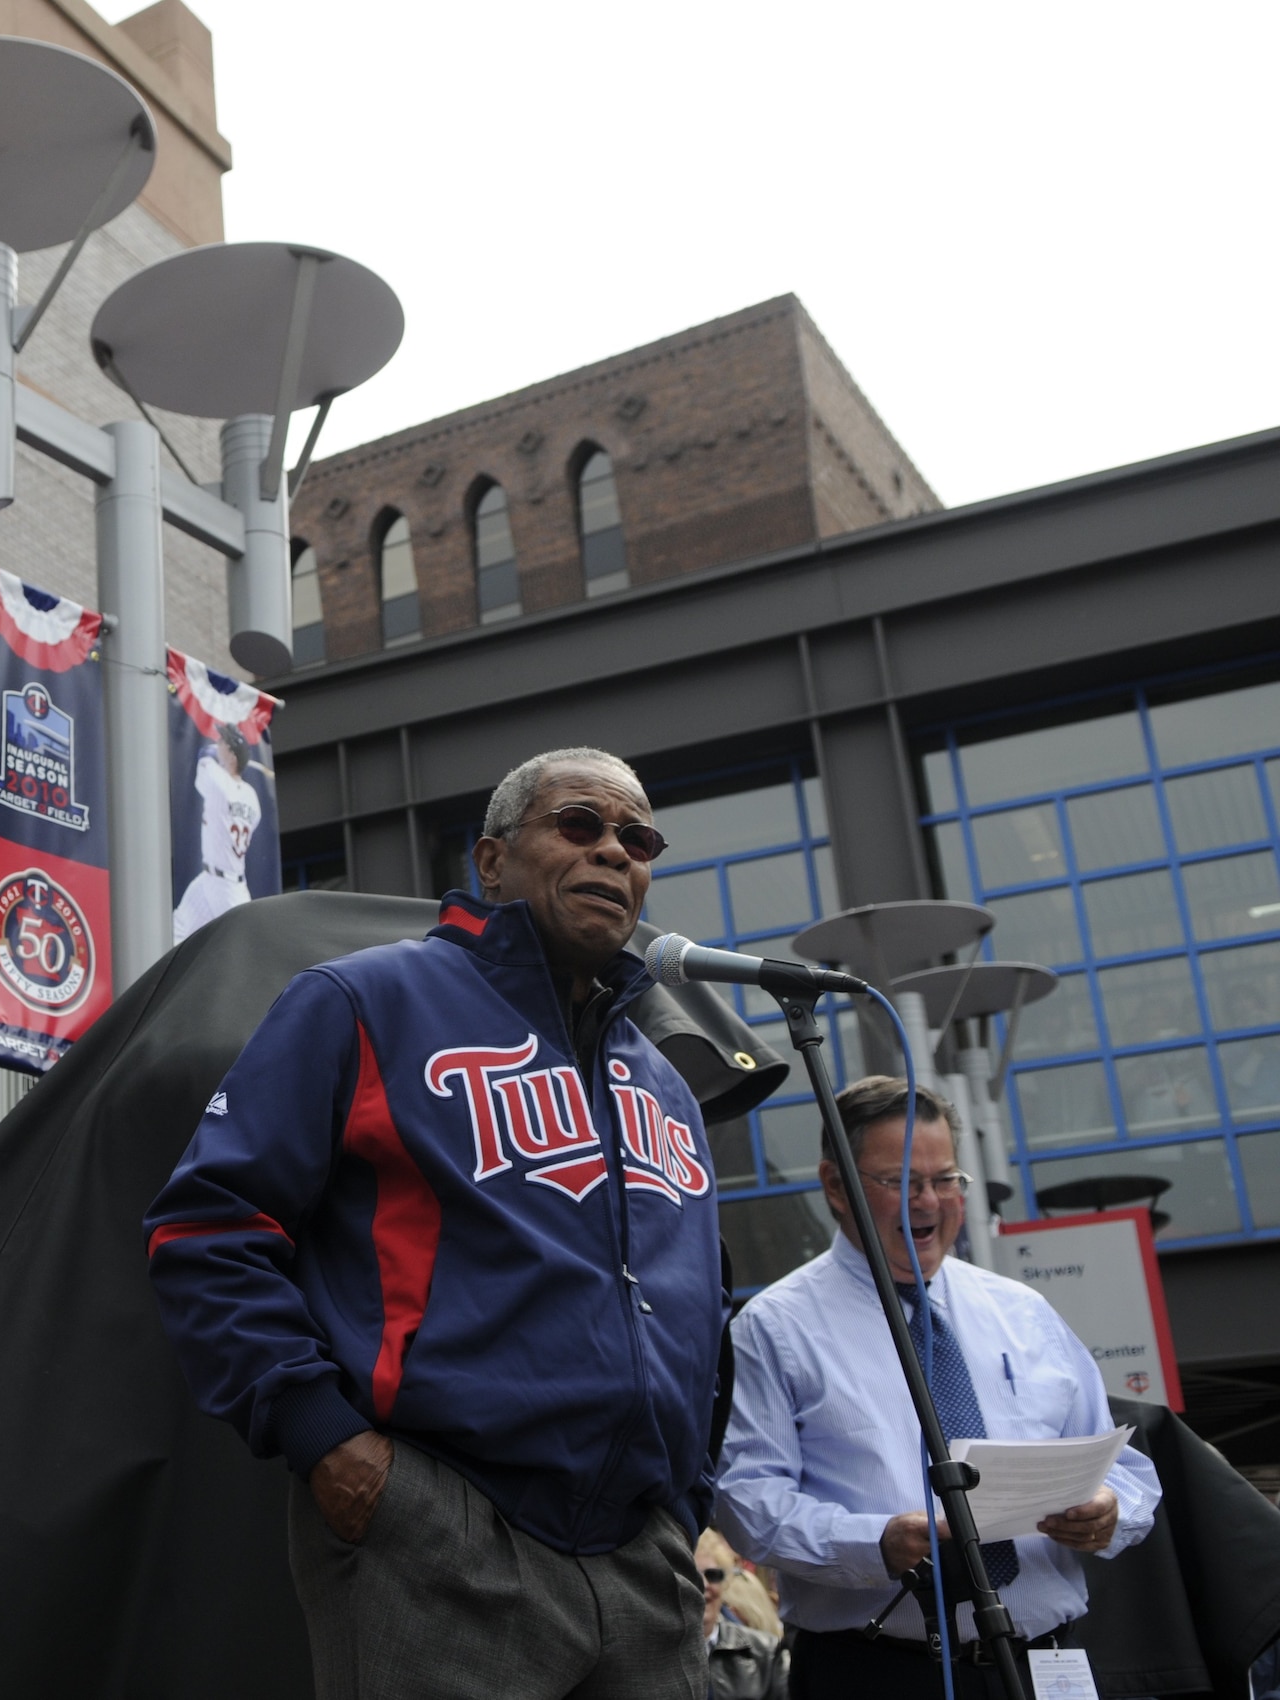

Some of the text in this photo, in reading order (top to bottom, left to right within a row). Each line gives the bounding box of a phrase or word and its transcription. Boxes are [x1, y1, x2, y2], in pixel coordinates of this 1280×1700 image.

[7, 744, 68, 775] INAUGURAL
[7, 756, 68, 788] SEASON
[6, 770, 69, 808] 2010
[48, 807, 81, 826] FIELD
[55, 898, 82, 936] 2010
[16, 916, 66, 974] 50
[0, 952, 81, 1002] FIFTY SEASONS
[424, 1033, 711, 1201] Twins
[1022, 1262, 1085, 1283] Skyway
[1091, 1343, 1147, 1361] Center
